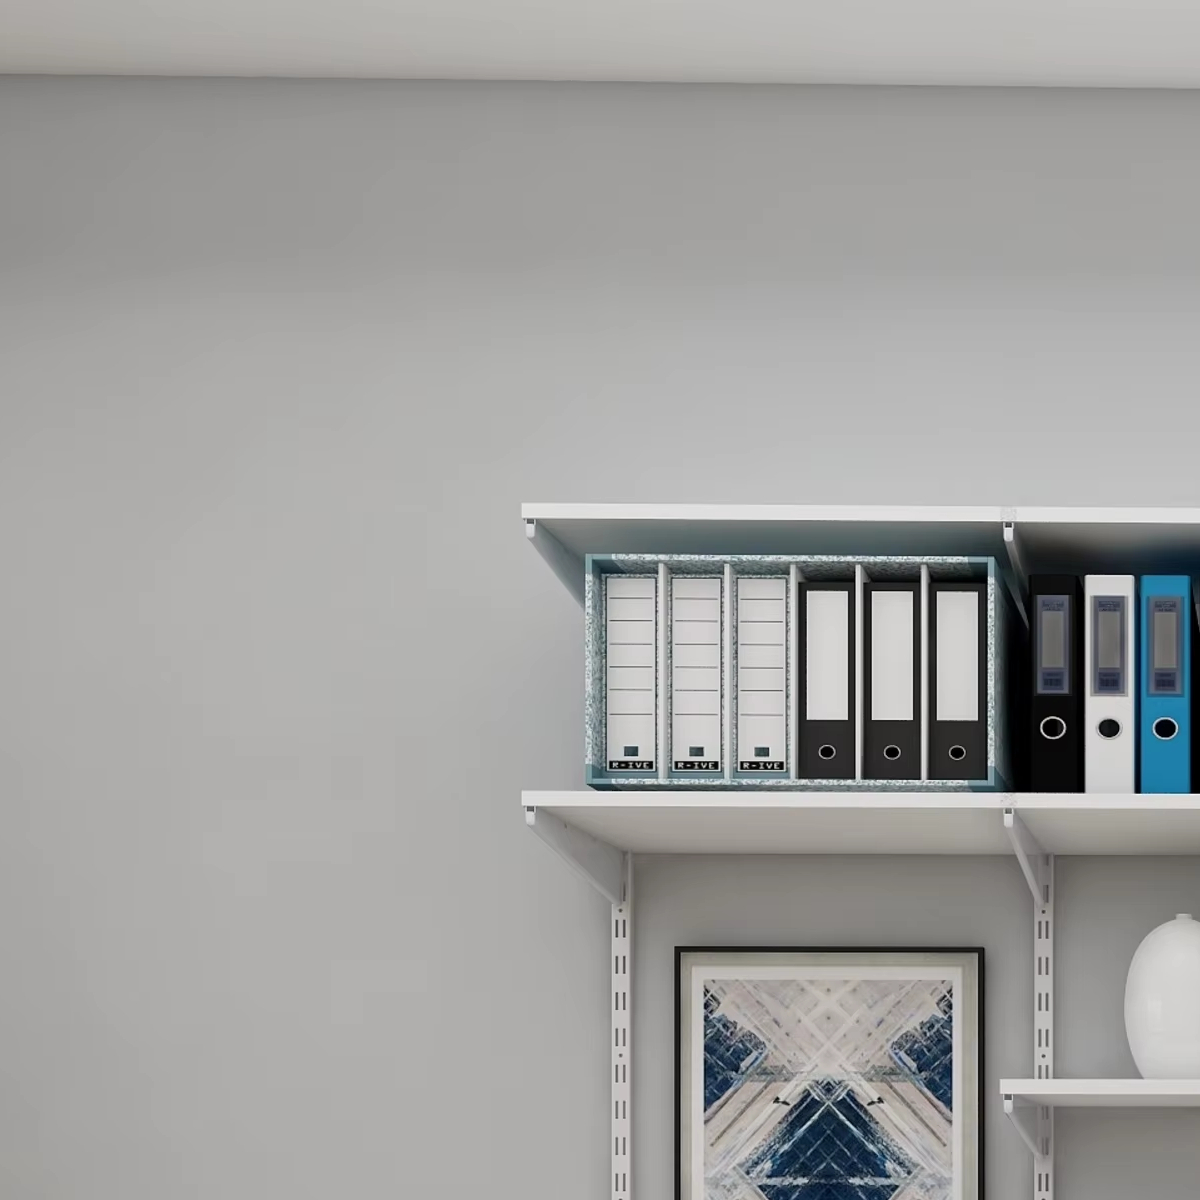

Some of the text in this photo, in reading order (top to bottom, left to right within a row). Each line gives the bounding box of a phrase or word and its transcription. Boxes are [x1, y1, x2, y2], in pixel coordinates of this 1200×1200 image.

[612, 762, 650, 770] R-IVE
[677, 762, 715, 770] R-IVE
[742, 762, 780, 770] R-IVE
